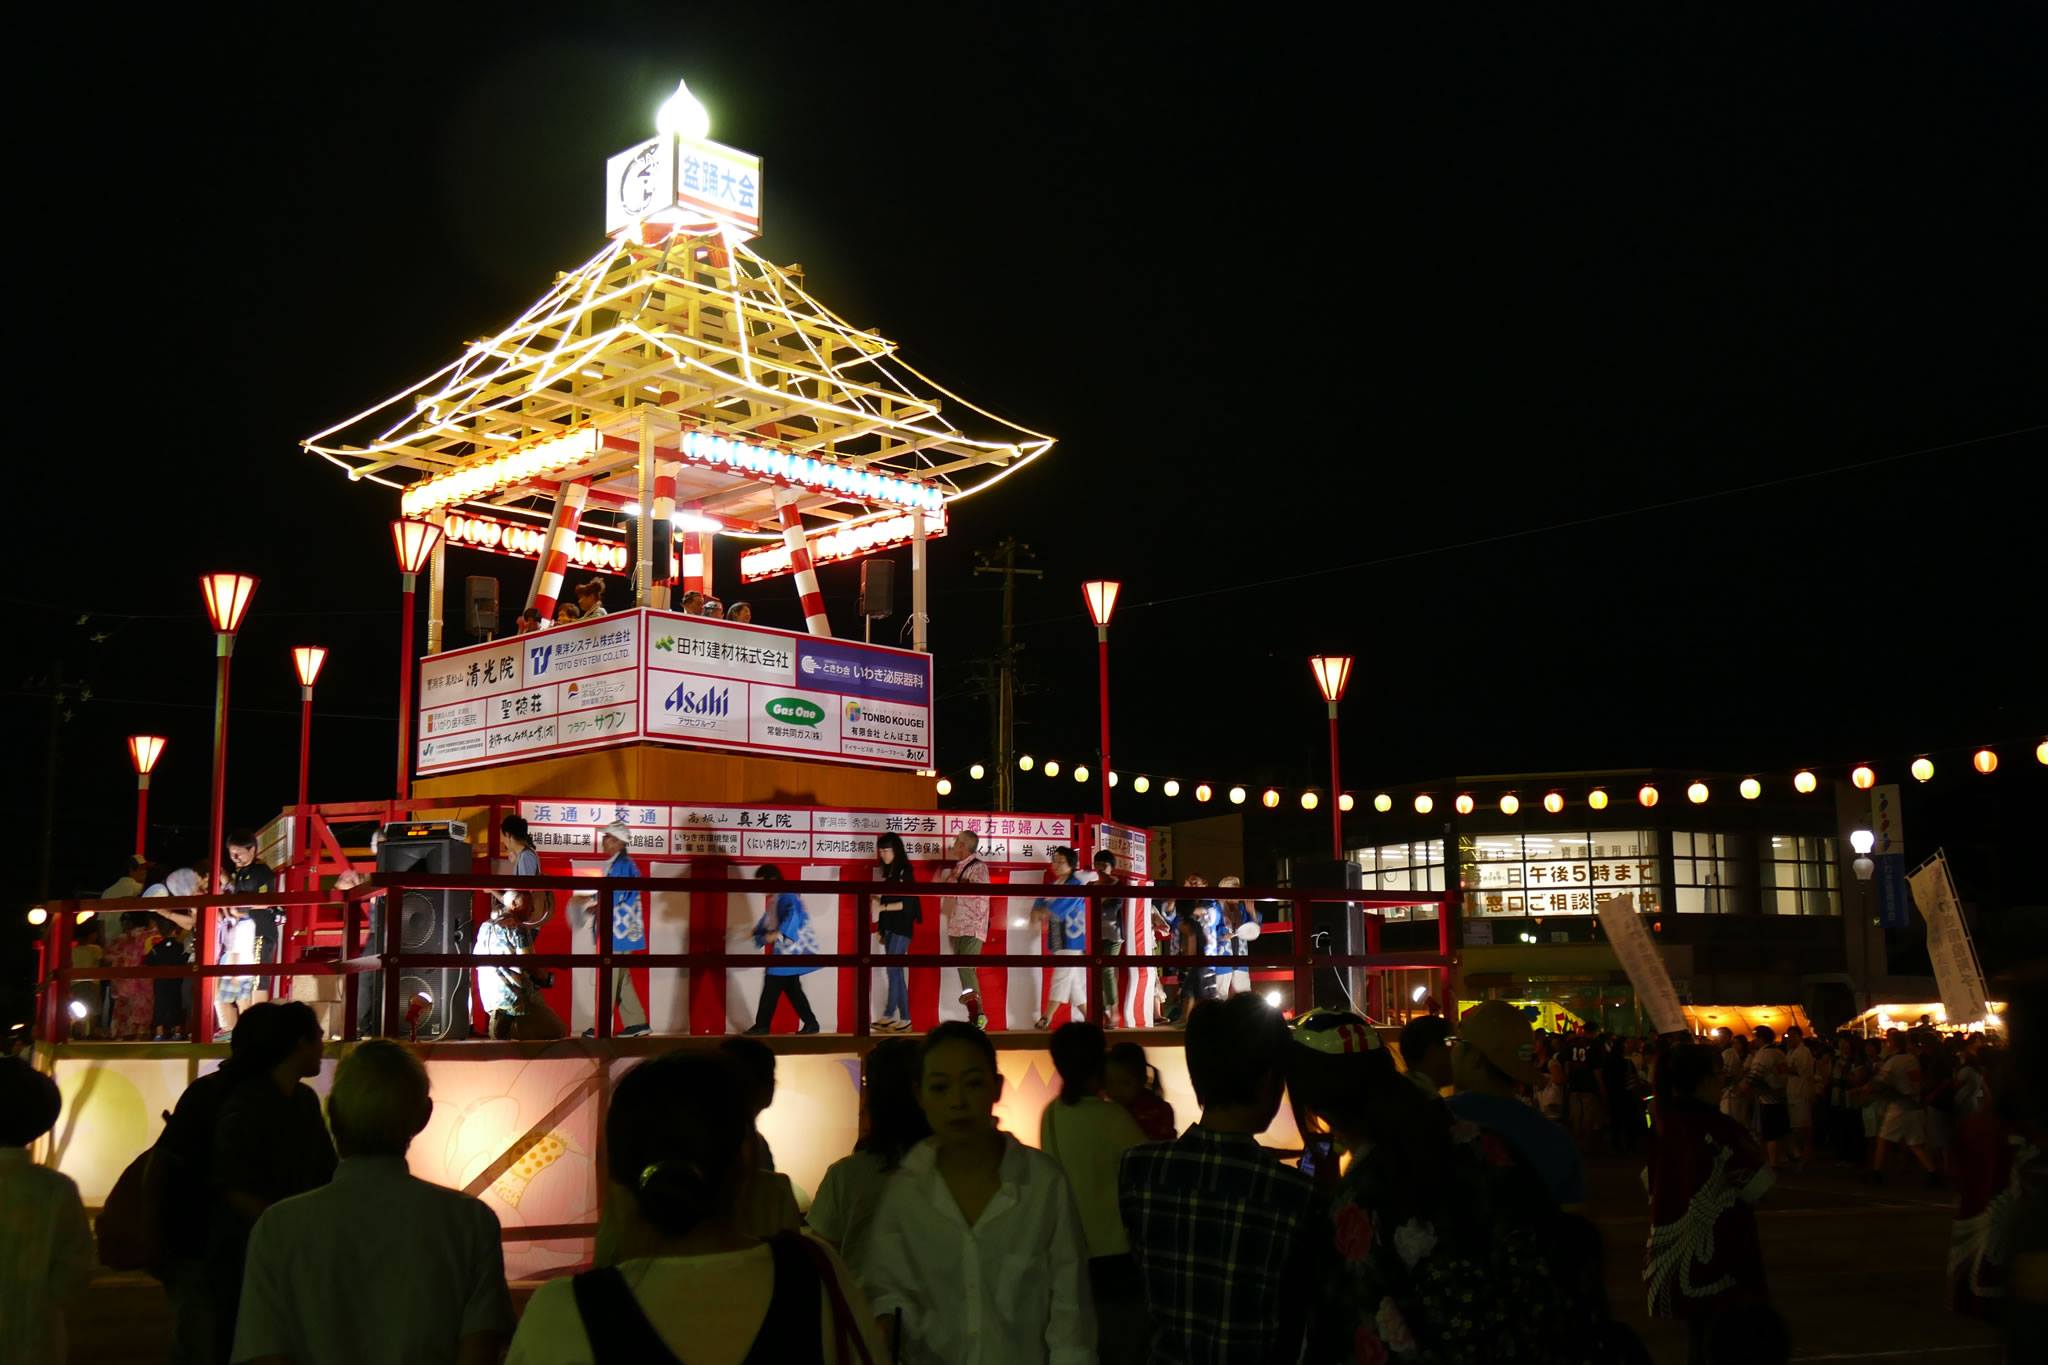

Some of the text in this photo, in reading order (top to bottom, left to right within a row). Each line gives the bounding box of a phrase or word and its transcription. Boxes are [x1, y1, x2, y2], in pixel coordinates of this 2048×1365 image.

[683, 155, 755, 209] 盆踊大会
[555, 628, 631, 656] 東洋システム株式会社
[677, 637, 789, 669] 田村建材株式会社
[466, 656, 514, 688] 清光院
[554, 661, 572, 672] TOYO
[574, 655, 602, 668] SYSTEM
[822, 663, 924, 689] ときわ会 いわき泌尿器科
[501, 693, 542, 720] 聖徳荘
[664, 681, 729, 718] Asahi
[773, 703, 816, 719] Gas One
[678, 717, 717, 728] アサヒグループ
[862, 712, 925, 729] TONBO KOUGEI
[851, 727, 881, 739] 有限会社
[534, 805, 657, 824] 浜通り交通
[737, 811, 793, 828] 真光院
[885, 816, 937, 832] 瑞芳寺
[950, 818, 1065, 836] 内郷方部婦人会
[746, 838, 808, 852] くにい内科クリニック
[816, 840, 875, 854] 大河内記念病院
